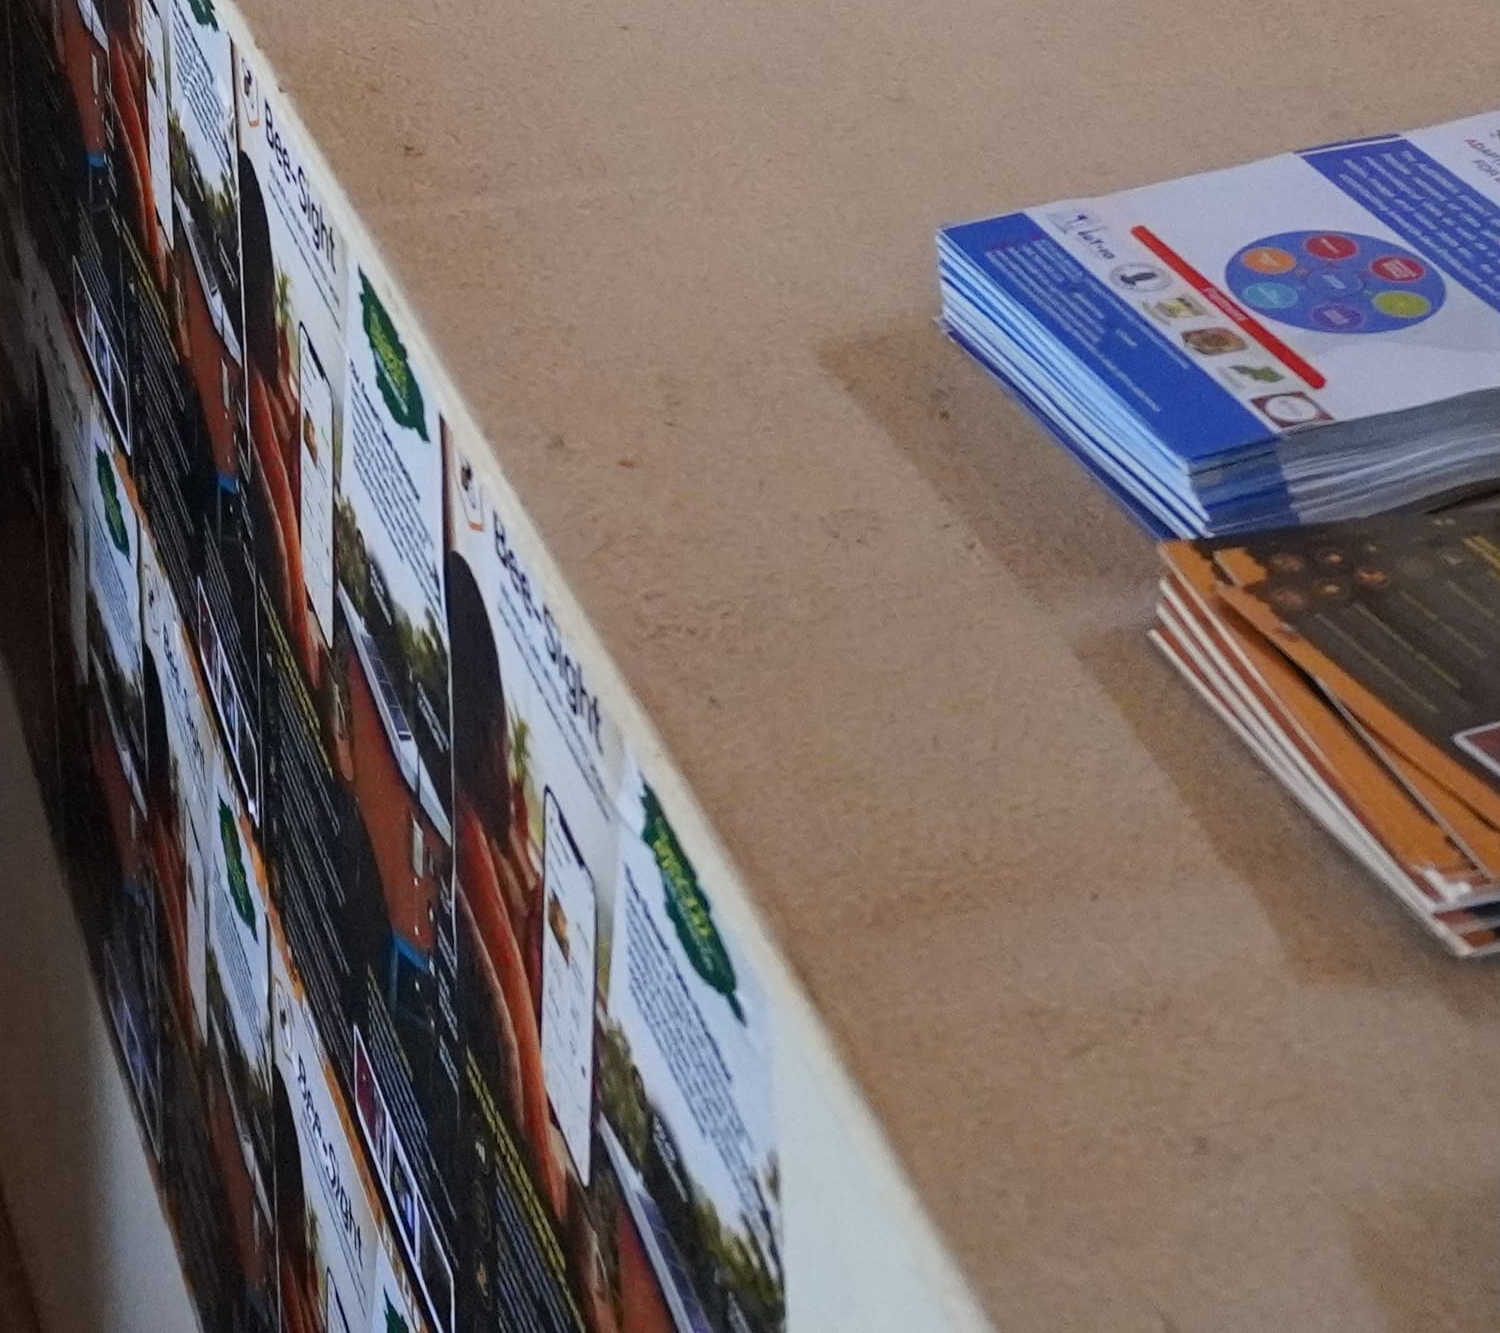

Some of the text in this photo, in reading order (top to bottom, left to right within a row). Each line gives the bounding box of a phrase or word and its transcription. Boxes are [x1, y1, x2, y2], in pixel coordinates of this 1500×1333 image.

[263, 99, 338, 275] Bee-Sight
[1470, 159, 1500, 176] FOR
[490, 509, 606, 756] Bee-Sight
[296, 1054, 365, 1270] Bee-Sight
